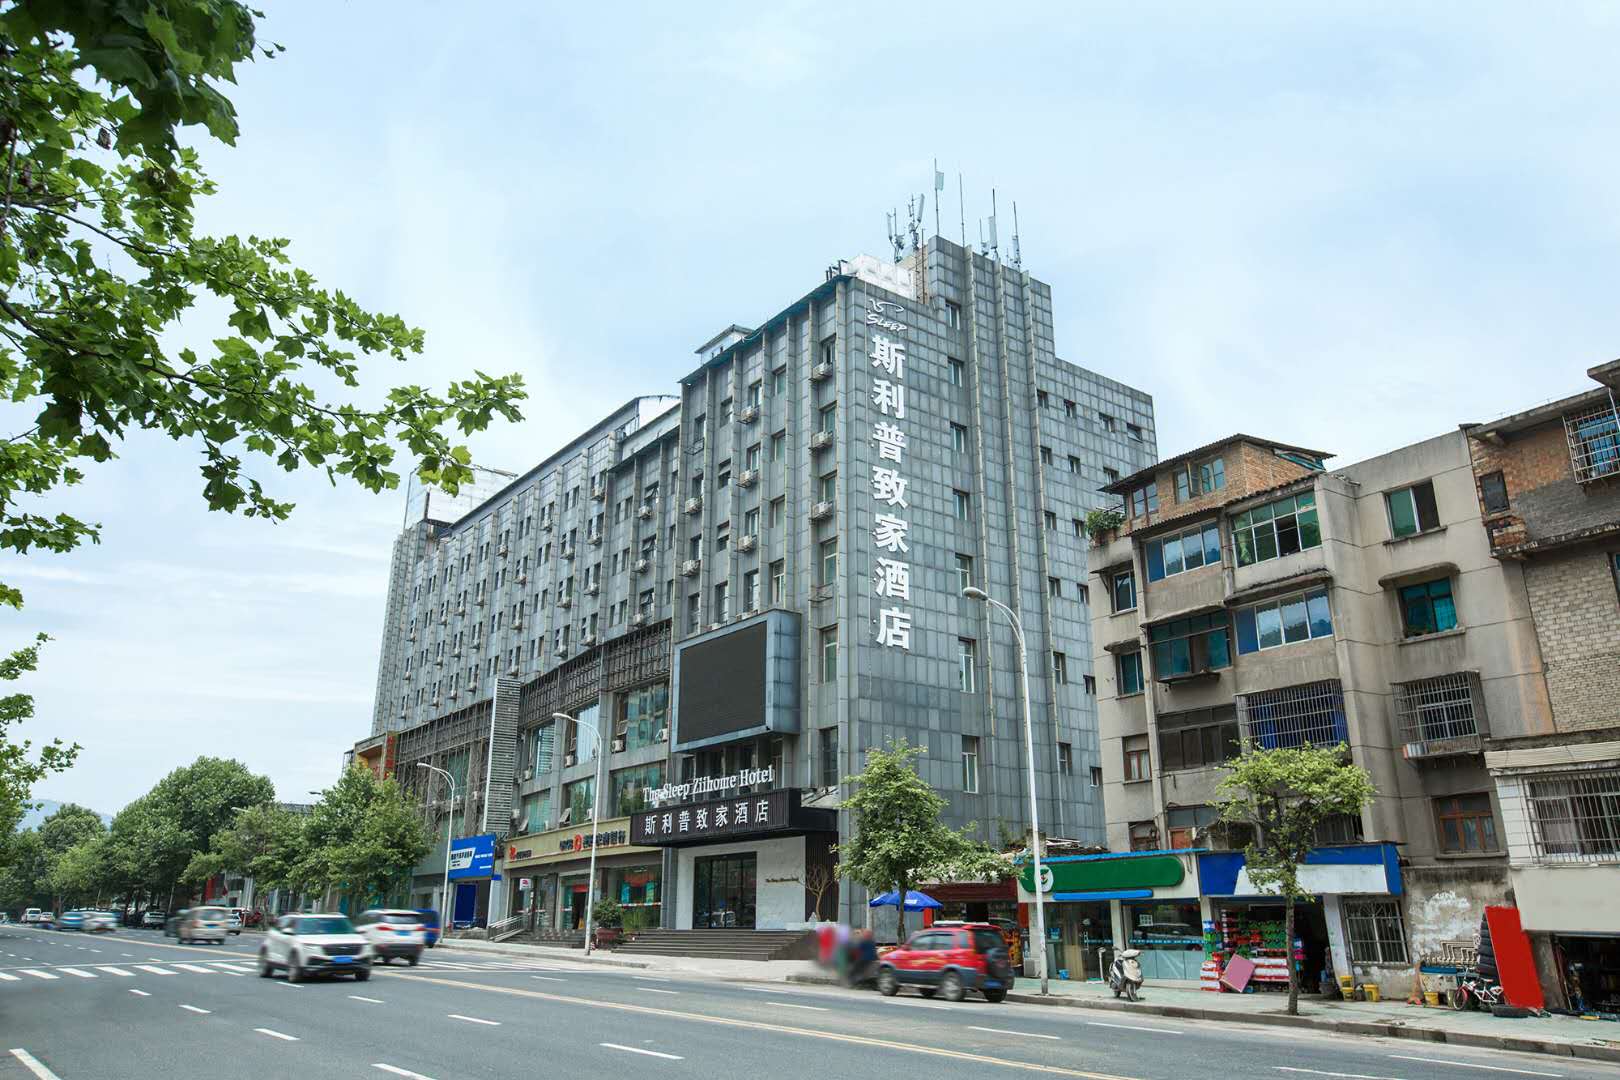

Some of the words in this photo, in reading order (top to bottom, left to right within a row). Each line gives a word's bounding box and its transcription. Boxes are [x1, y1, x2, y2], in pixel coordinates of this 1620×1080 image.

[871, 335, 911, 649] 斯利普致家酒店
[662, 782, 690, 800] Sleep
[739, 765, 774, 787] Hotel
[644, 800, 769, 835] 斯利普致家酒店
